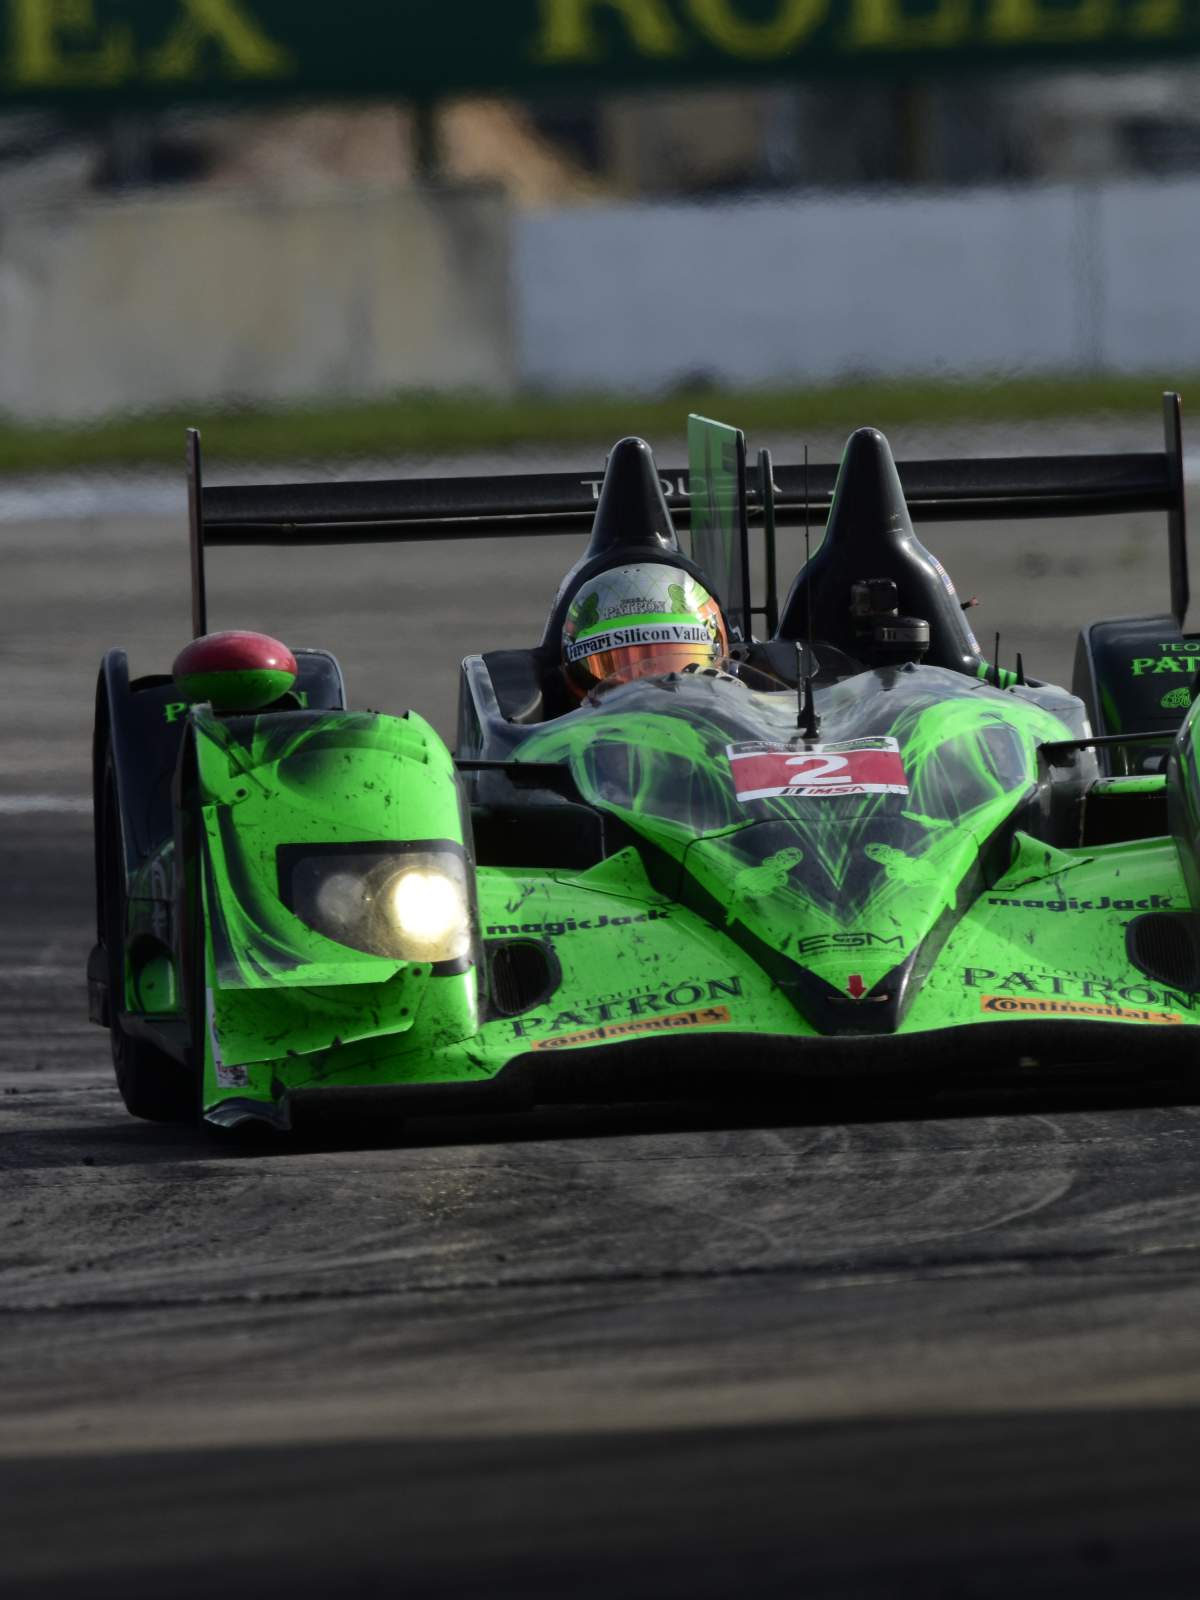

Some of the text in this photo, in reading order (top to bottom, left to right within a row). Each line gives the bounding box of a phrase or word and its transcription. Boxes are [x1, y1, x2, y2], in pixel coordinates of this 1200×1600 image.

[614, 628, 670, 645] Silicon
[785, 755, 852, 785] 2
[988, 894, 1175, 912] magicJack
[486, 909, 672, 936] magicJack
[798, 932, 904, 954] ESM
[984, 996, 1151, 1021] Continental
[536, 1011, 699, 1050] Continental
